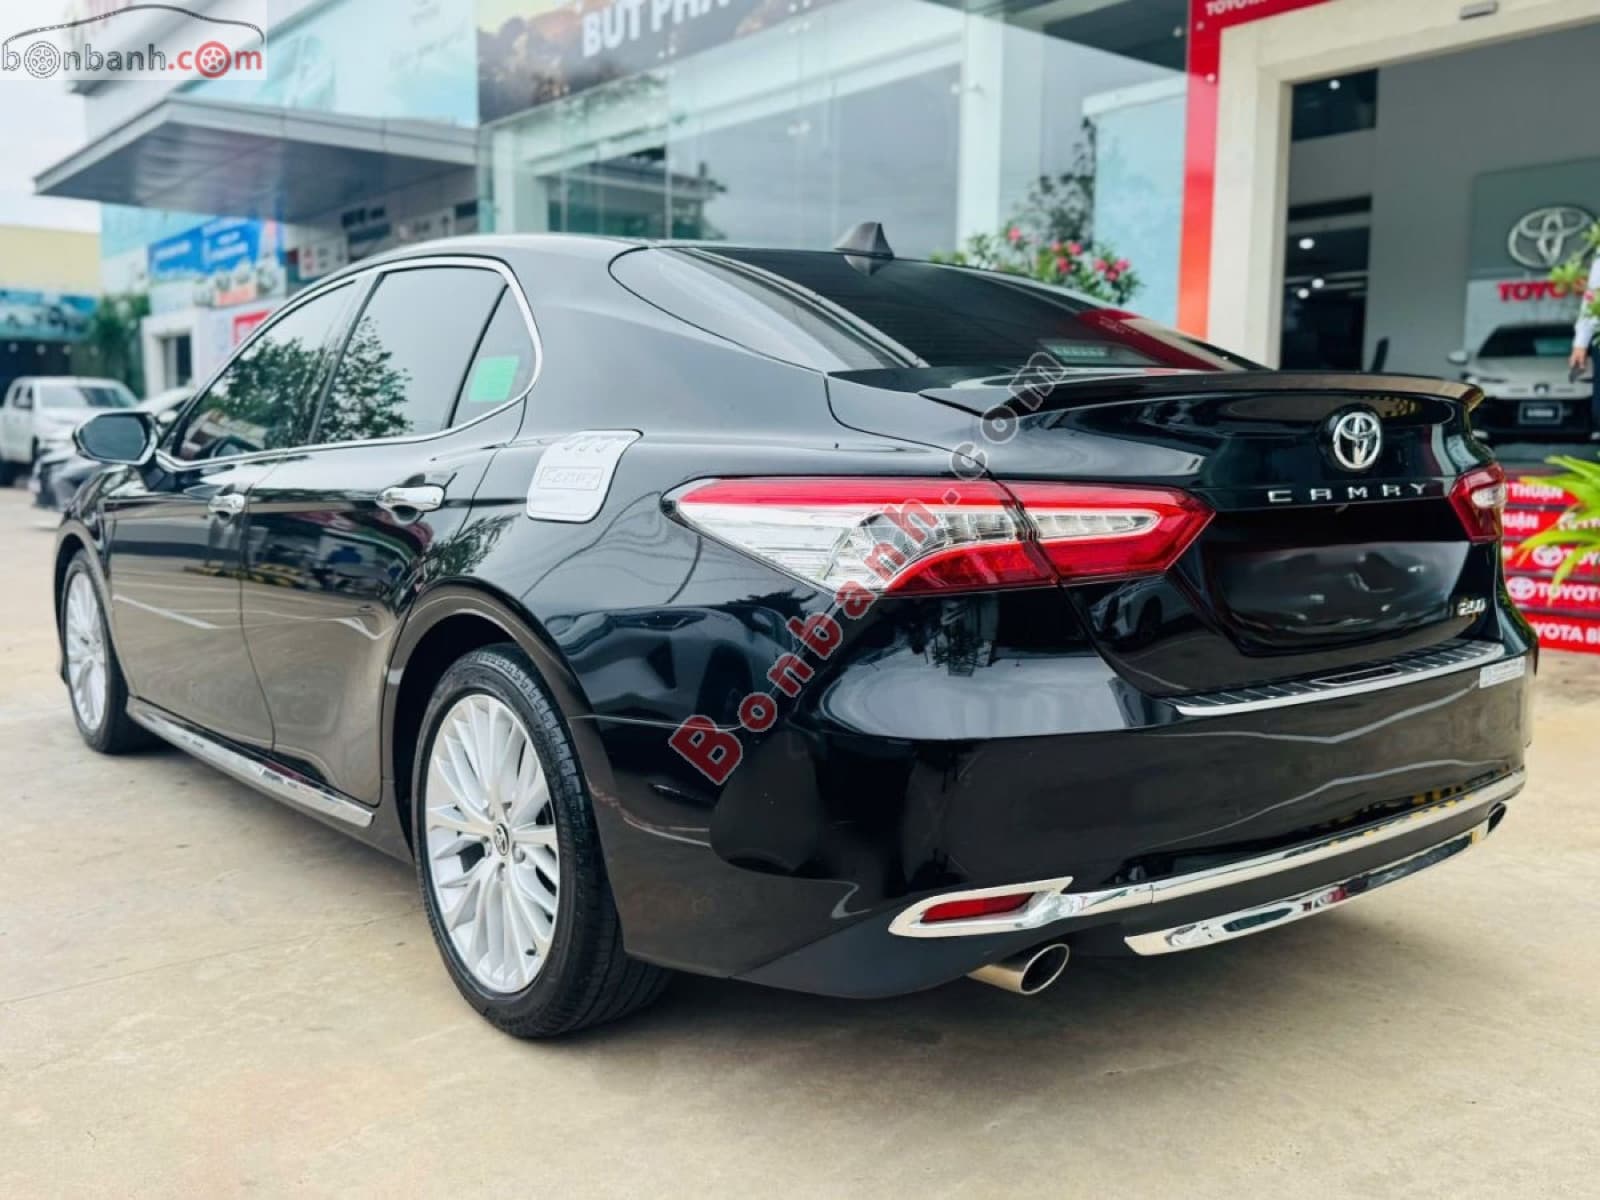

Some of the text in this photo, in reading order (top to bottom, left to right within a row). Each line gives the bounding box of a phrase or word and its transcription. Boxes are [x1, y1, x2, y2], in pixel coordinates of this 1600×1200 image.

[1206, 0, 1267, 16] TOYO
[1268, 483, 1426, 502] CAMRY
[1536, 582, 1600, 602] TOYOT
[1529, 621, 1584, 643] YOTA
